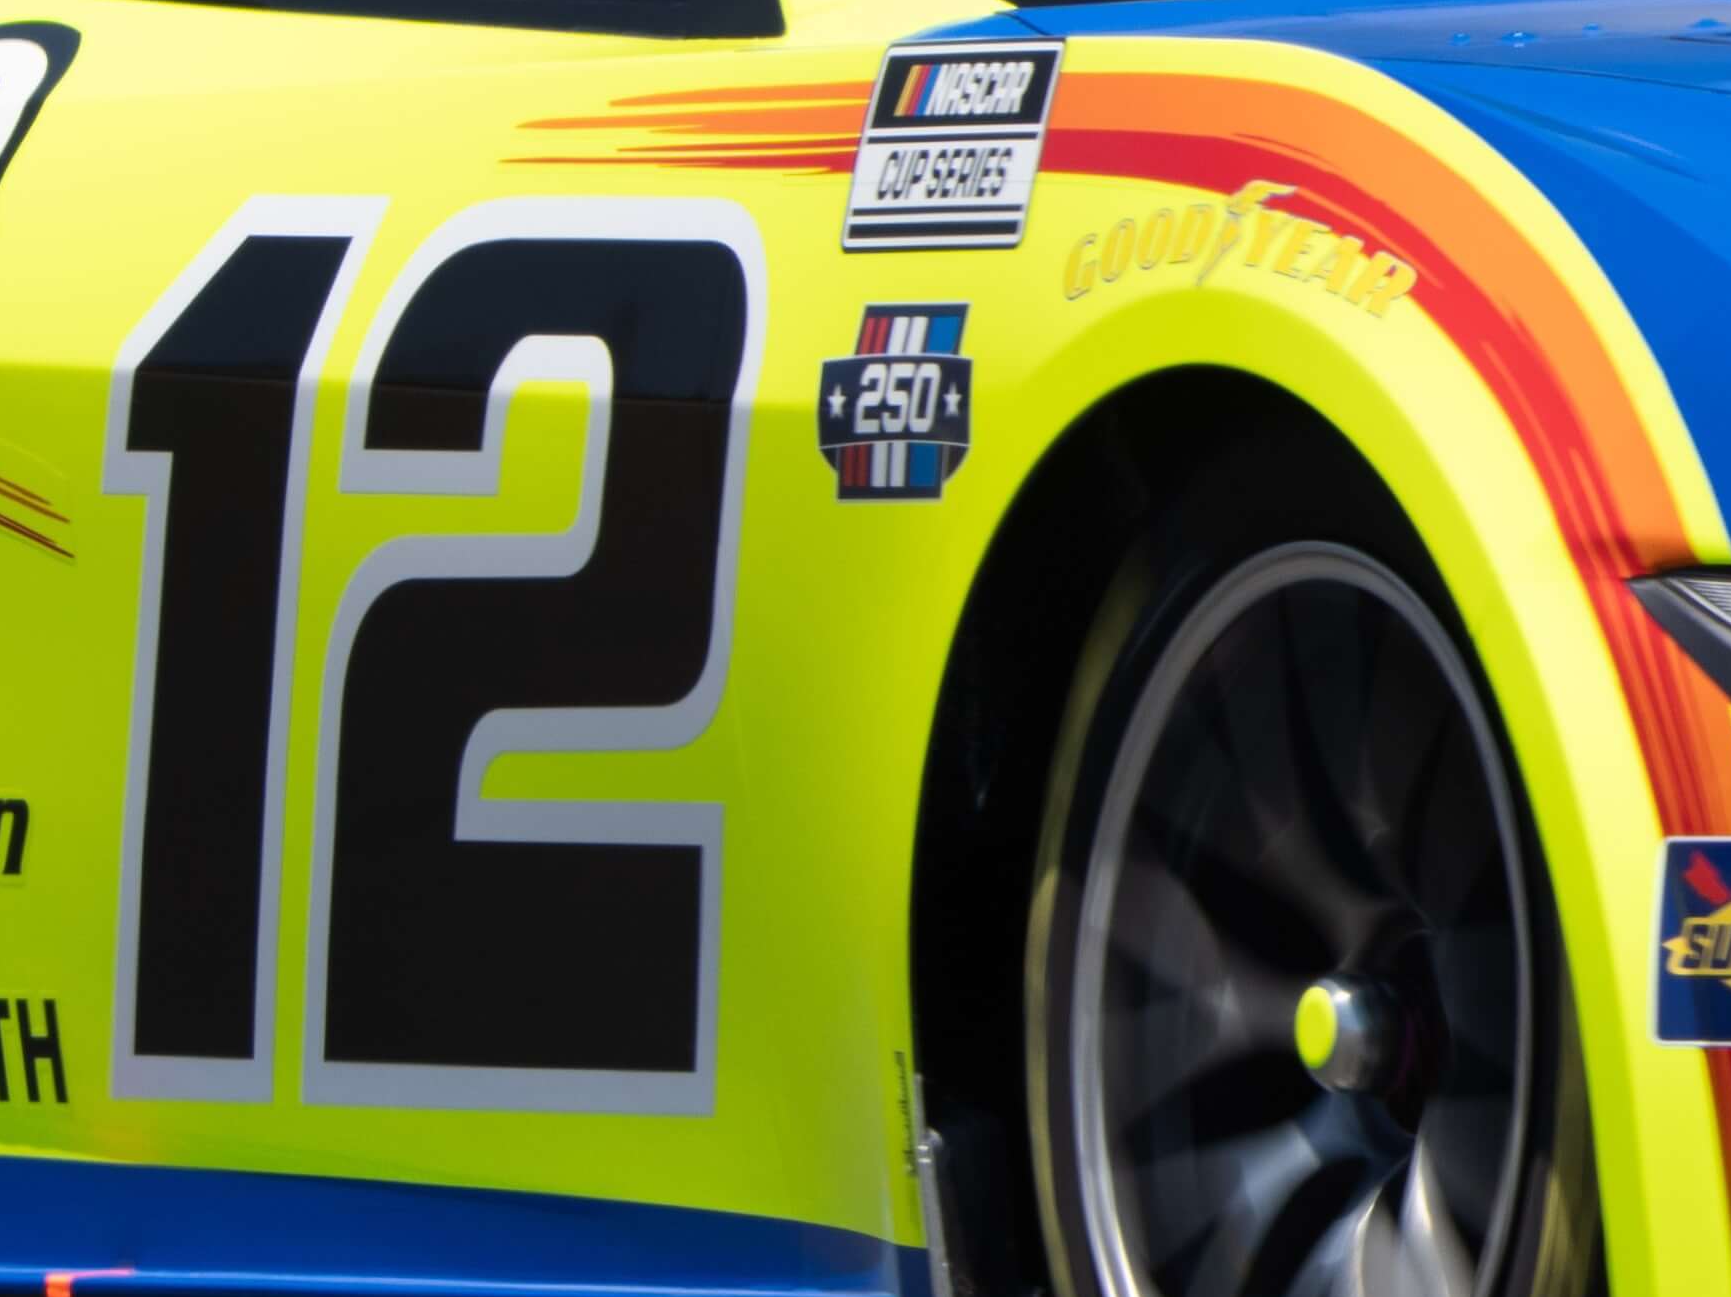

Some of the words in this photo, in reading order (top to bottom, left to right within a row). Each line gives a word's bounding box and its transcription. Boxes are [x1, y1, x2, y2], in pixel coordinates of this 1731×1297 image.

[925, 62, 1036, 117] NASCAR
[877, 150, 930, 200] CUP
[925, 147, 1013, 199] SERIES
[1063, 179, 1419, 318] GOODYEAR
[853, 362, 941, 435] 250
[102, 194, 767, 1118] 12
